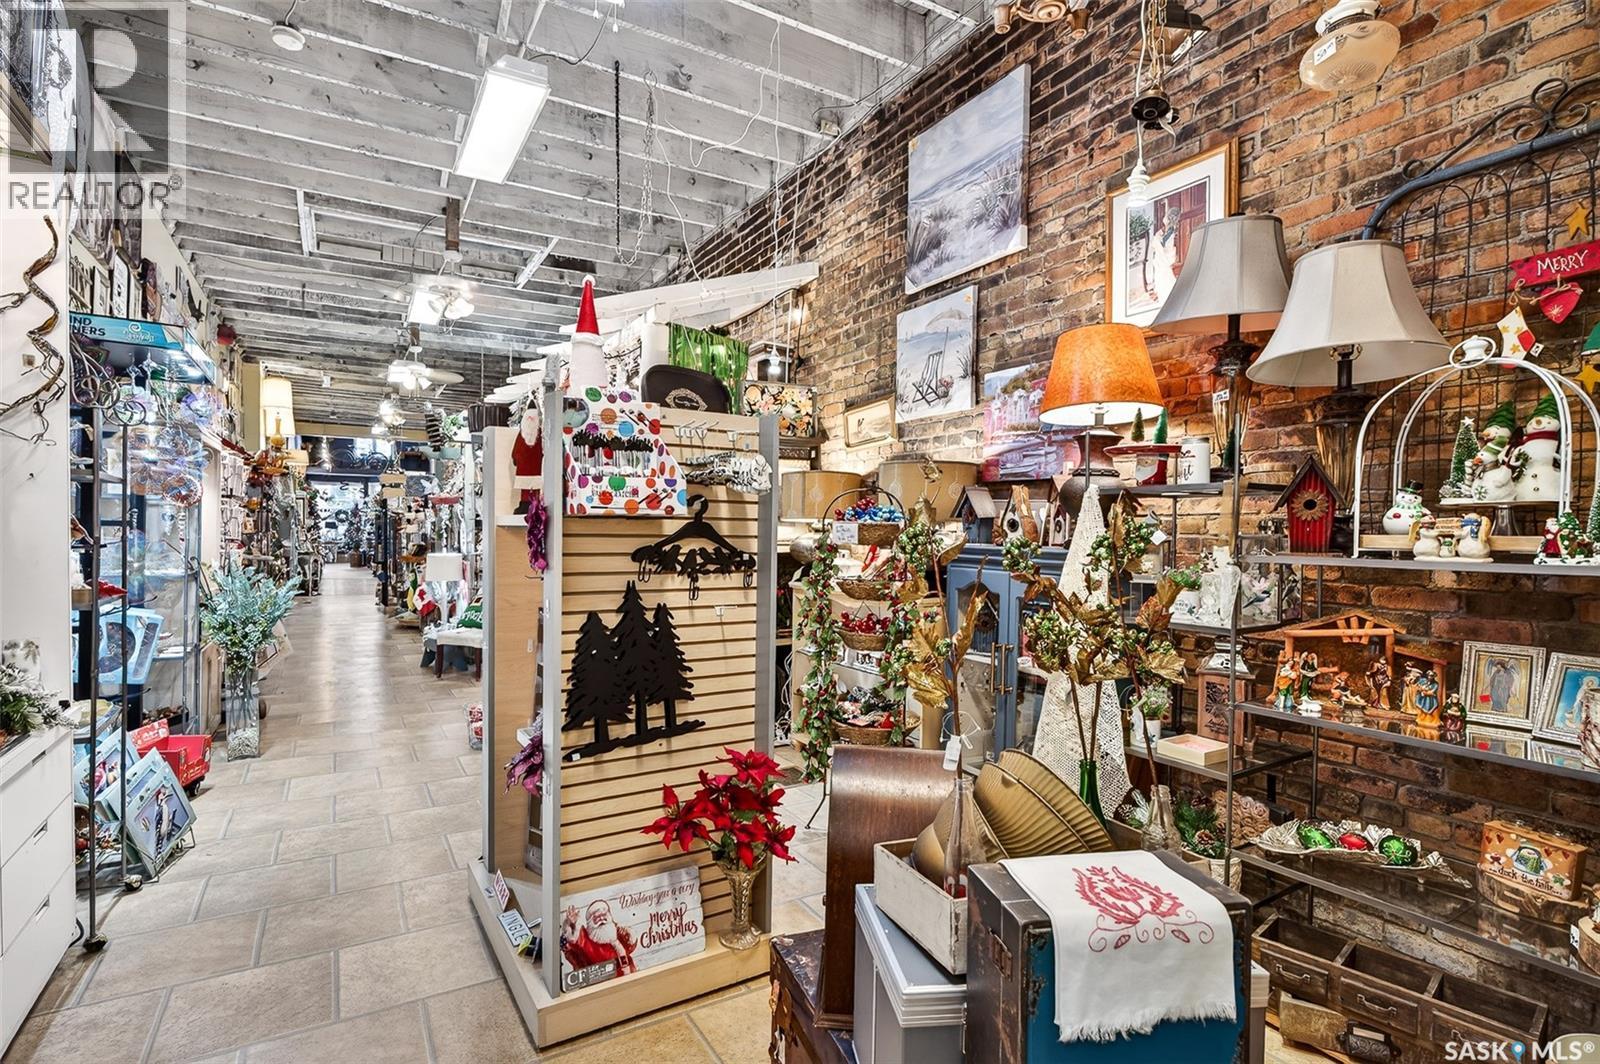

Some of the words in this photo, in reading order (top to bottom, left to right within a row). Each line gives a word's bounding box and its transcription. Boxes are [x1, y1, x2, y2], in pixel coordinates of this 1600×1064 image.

[1537, 249, 1588, 276] MERRY
[501, 912, 529, 942] JINGLE
[640, 920, 698, 949] Christmas
